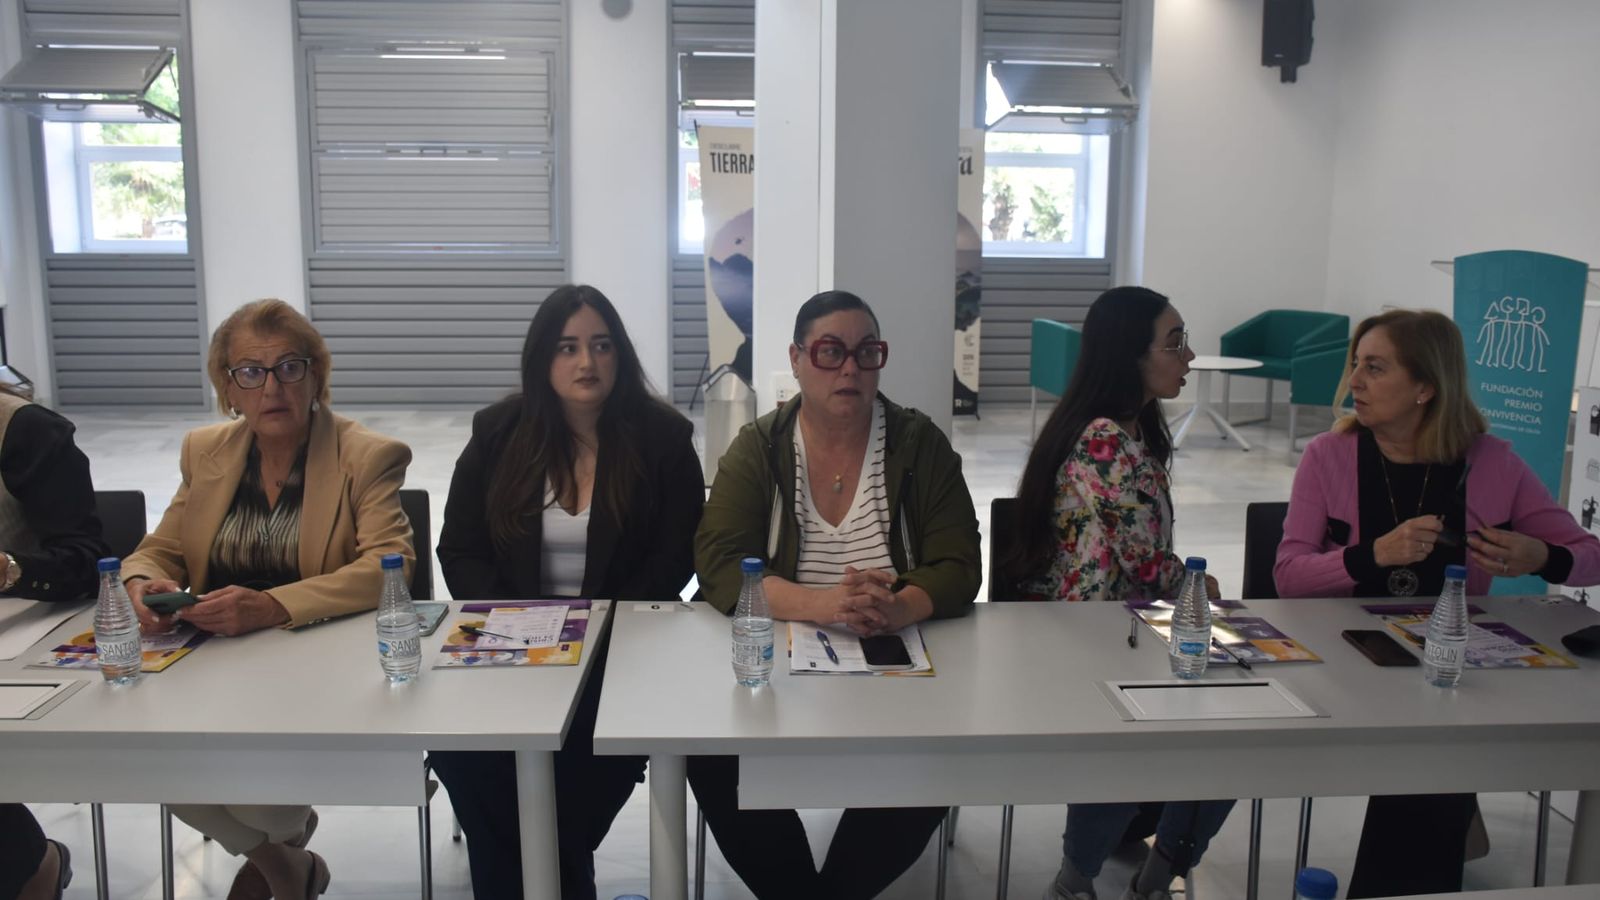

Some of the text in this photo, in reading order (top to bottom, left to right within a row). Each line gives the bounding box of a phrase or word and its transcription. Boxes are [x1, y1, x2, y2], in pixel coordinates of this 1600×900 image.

[709, 152, 754, 174] TIERRA
[1480, 382, 1543, 399] FUNDACIÓN
[1504, 399, 1543, 412] PREMIO
[1480, 408, 1541, 424] ONVIVENCIA
